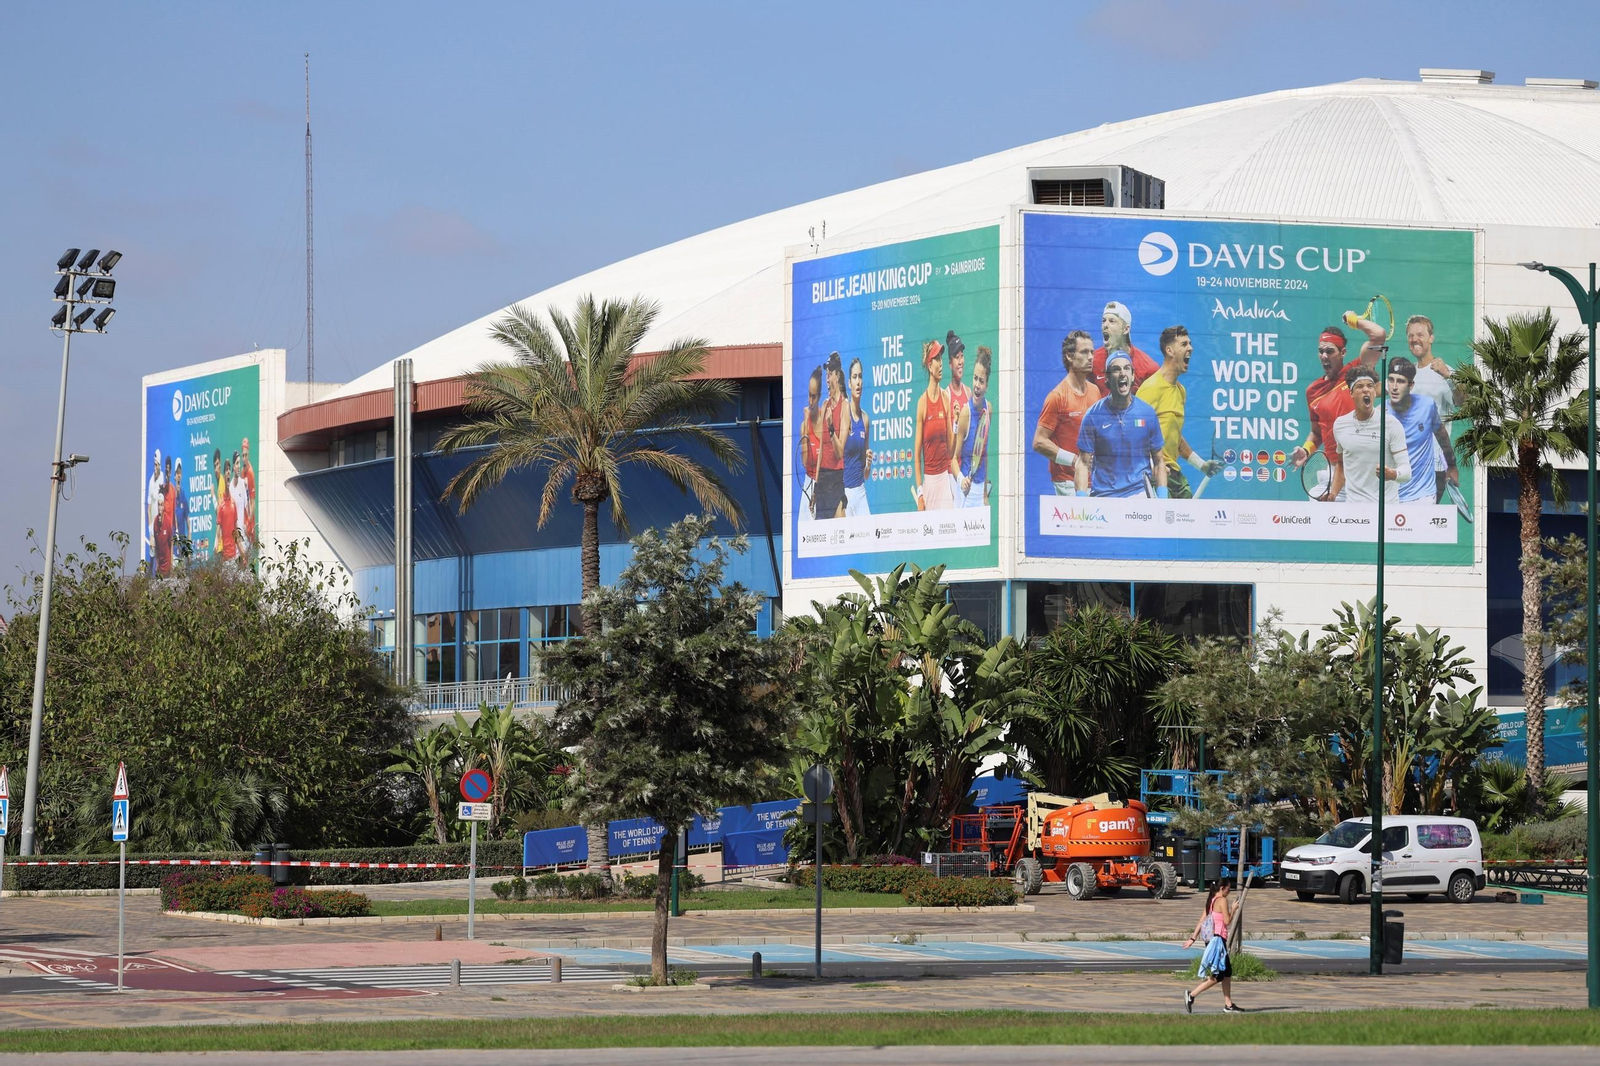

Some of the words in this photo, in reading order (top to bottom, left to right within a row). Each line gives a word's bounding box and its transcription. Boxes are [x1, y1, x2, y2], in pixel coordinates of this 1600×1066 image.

[1187, 242, 1285, 270] DAVIS
[1295, 246, 1366, 273] CUP
[812, 277, 845, 304] BILLIE
[845, 271, 876, 298] JEAN
[877, 266, 906, 292] KING
[907, 262, 933, 287] CUP
[950, 257, 986, 275] GAINBRIDGE
[1196, 276, 1222, 288] 19-24
[1225, 277, 1282, 289] NOVIEMBRE
[1284, 279, 1309, 290] 2024
[883, 296, 910, 309] NOVIEMBRE
[909, 294, 921, 306] 2024
[1211, 298, 1292, 322] Andalucía
[881, 335, 904, 359] THE
[1231, 332, 1279, 356] THE
[872, 361, 913, 387] WORLD
[1211, 359, 1298, 385] WORLD
[184, 390, 210, 412] DAVIS
[211, 386, 231, 407] CUP
[872, 390, 895, 415] CUP
[897, 388, 913, 412] OF
[1212, 388, 1261, 411] CUP
[1266, 389, 1298, 412] OF
[871, 416, 913, 442] TENNIS
[1210, 416, 1299, 441] TENNIS
[194, 454, 208, 472] THE
[189, 474, 212, 493] WORLD
[189, 496, 202, 513] CUP
[203, 495, 212, 511] OF
[188, 514, 212, 533] TENNIS
[1051, 506, 1109, 524] Andalucía
[1125, 511, 1153, 521] málaga
[1281, 515, 1312, 525] UniCredit
[1429, 517, 1448, 525] ATP
[1496, 721, 1514, 730] WORLD
[1514, 720, 1525, 728] CUP
[1500, 729, 1518, 738] TENNIS
[756, 812, 770, 822] THE
[765, 821, 775, 830] OF
[613, 830, 627, 840] THE
[627, 827, 651, 838] WORLD
[651, 825, 666, 835] CUP
[622, 839, 632, 848] OF
[632, 836, 656, 847] TENNIS
